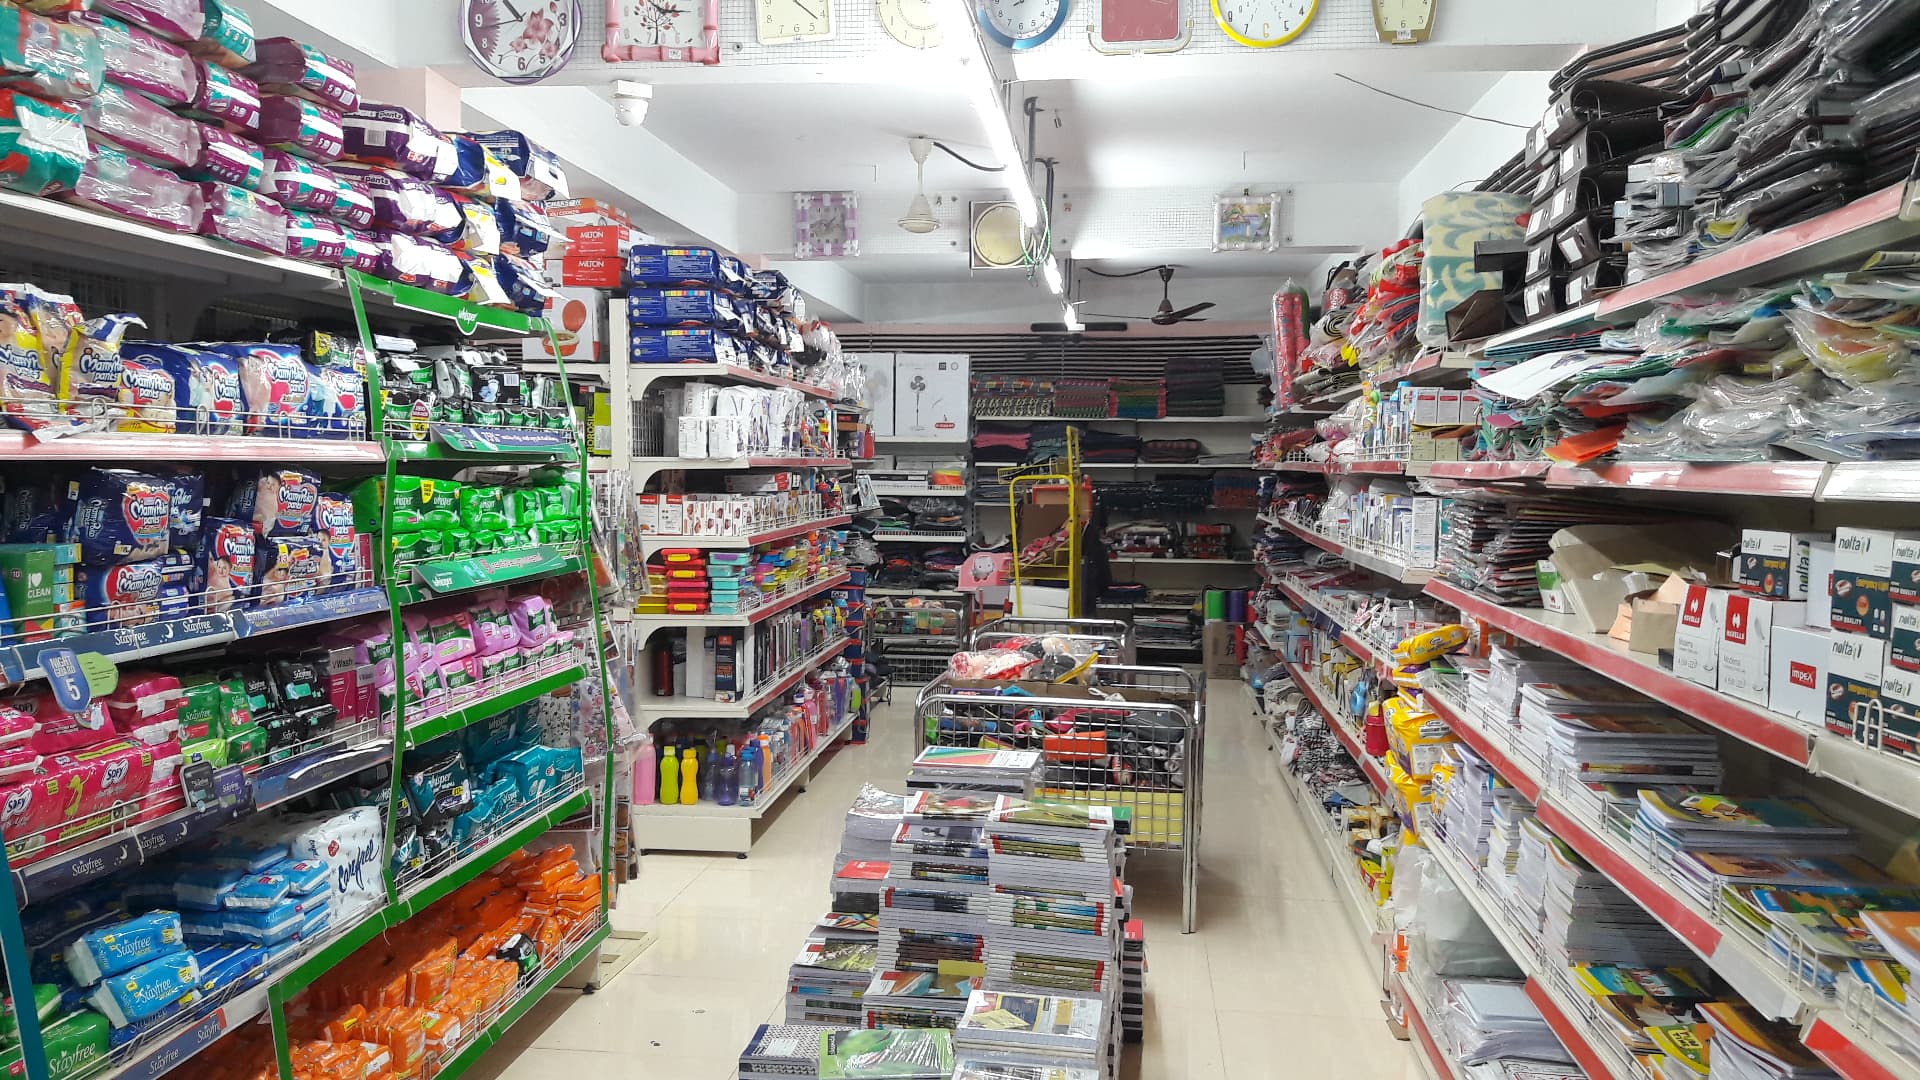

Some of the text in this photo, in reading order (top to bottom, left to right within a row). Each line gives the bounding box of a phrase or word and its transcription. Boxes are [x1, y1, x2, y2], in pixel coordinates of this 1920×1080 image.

[475, 13, 483, 27] 9
[559, 12, 567, 27] 3
[766, 14, 773, 24] 8
[778, 24, 784, 34] 7
[793, 24, 801, 33] 6
[809, 24, 816, 32] 5
[481, 38, 488, 49] 8
[498, 54, 504, 65] 7
[517, 56, 526, 71] 6
[539, 53, 546, 64] 5
[365, 175, 389, 185] pants
[580, 231, 604, 239] MILTON
[578, 260, 605, 268] MILTON
[122, 368, 173, 393] MamyPoko
[139, 387, 160, 400] pants
[278, 481, 315, 505] MamyPoko
[117, 569, 162, 597] MamyPoko
[182, 618, 213, 634] Stayfree
[1683, 614, 1701, 624] HAVELLS
[1844, 616, 1862, 626] QUALITY
[114, 629, 147, 647] Stayfree
[1726, 629, 1745, 640] HAVELLS
[1791, 669, 1814, 683] impex
[64, 677, 81, 701] 5
[184, 708, 211, 723] Stayfree
[107, 767, 125, 780] SOFY
[7, 798, 27, 814] SOFY
[72, 857, 103, 877] Stayfree
[337, 838, 380, 895] Carefree
[116, 935, 152, 958] Stayfree
[139, 978, 172, 1004] Stayfree
[197, 1022, 220, 1044] Stayfr
[49, 1041, 97, 1080] Stayfree
[149, 1047, 179, 1076] Stayfree
